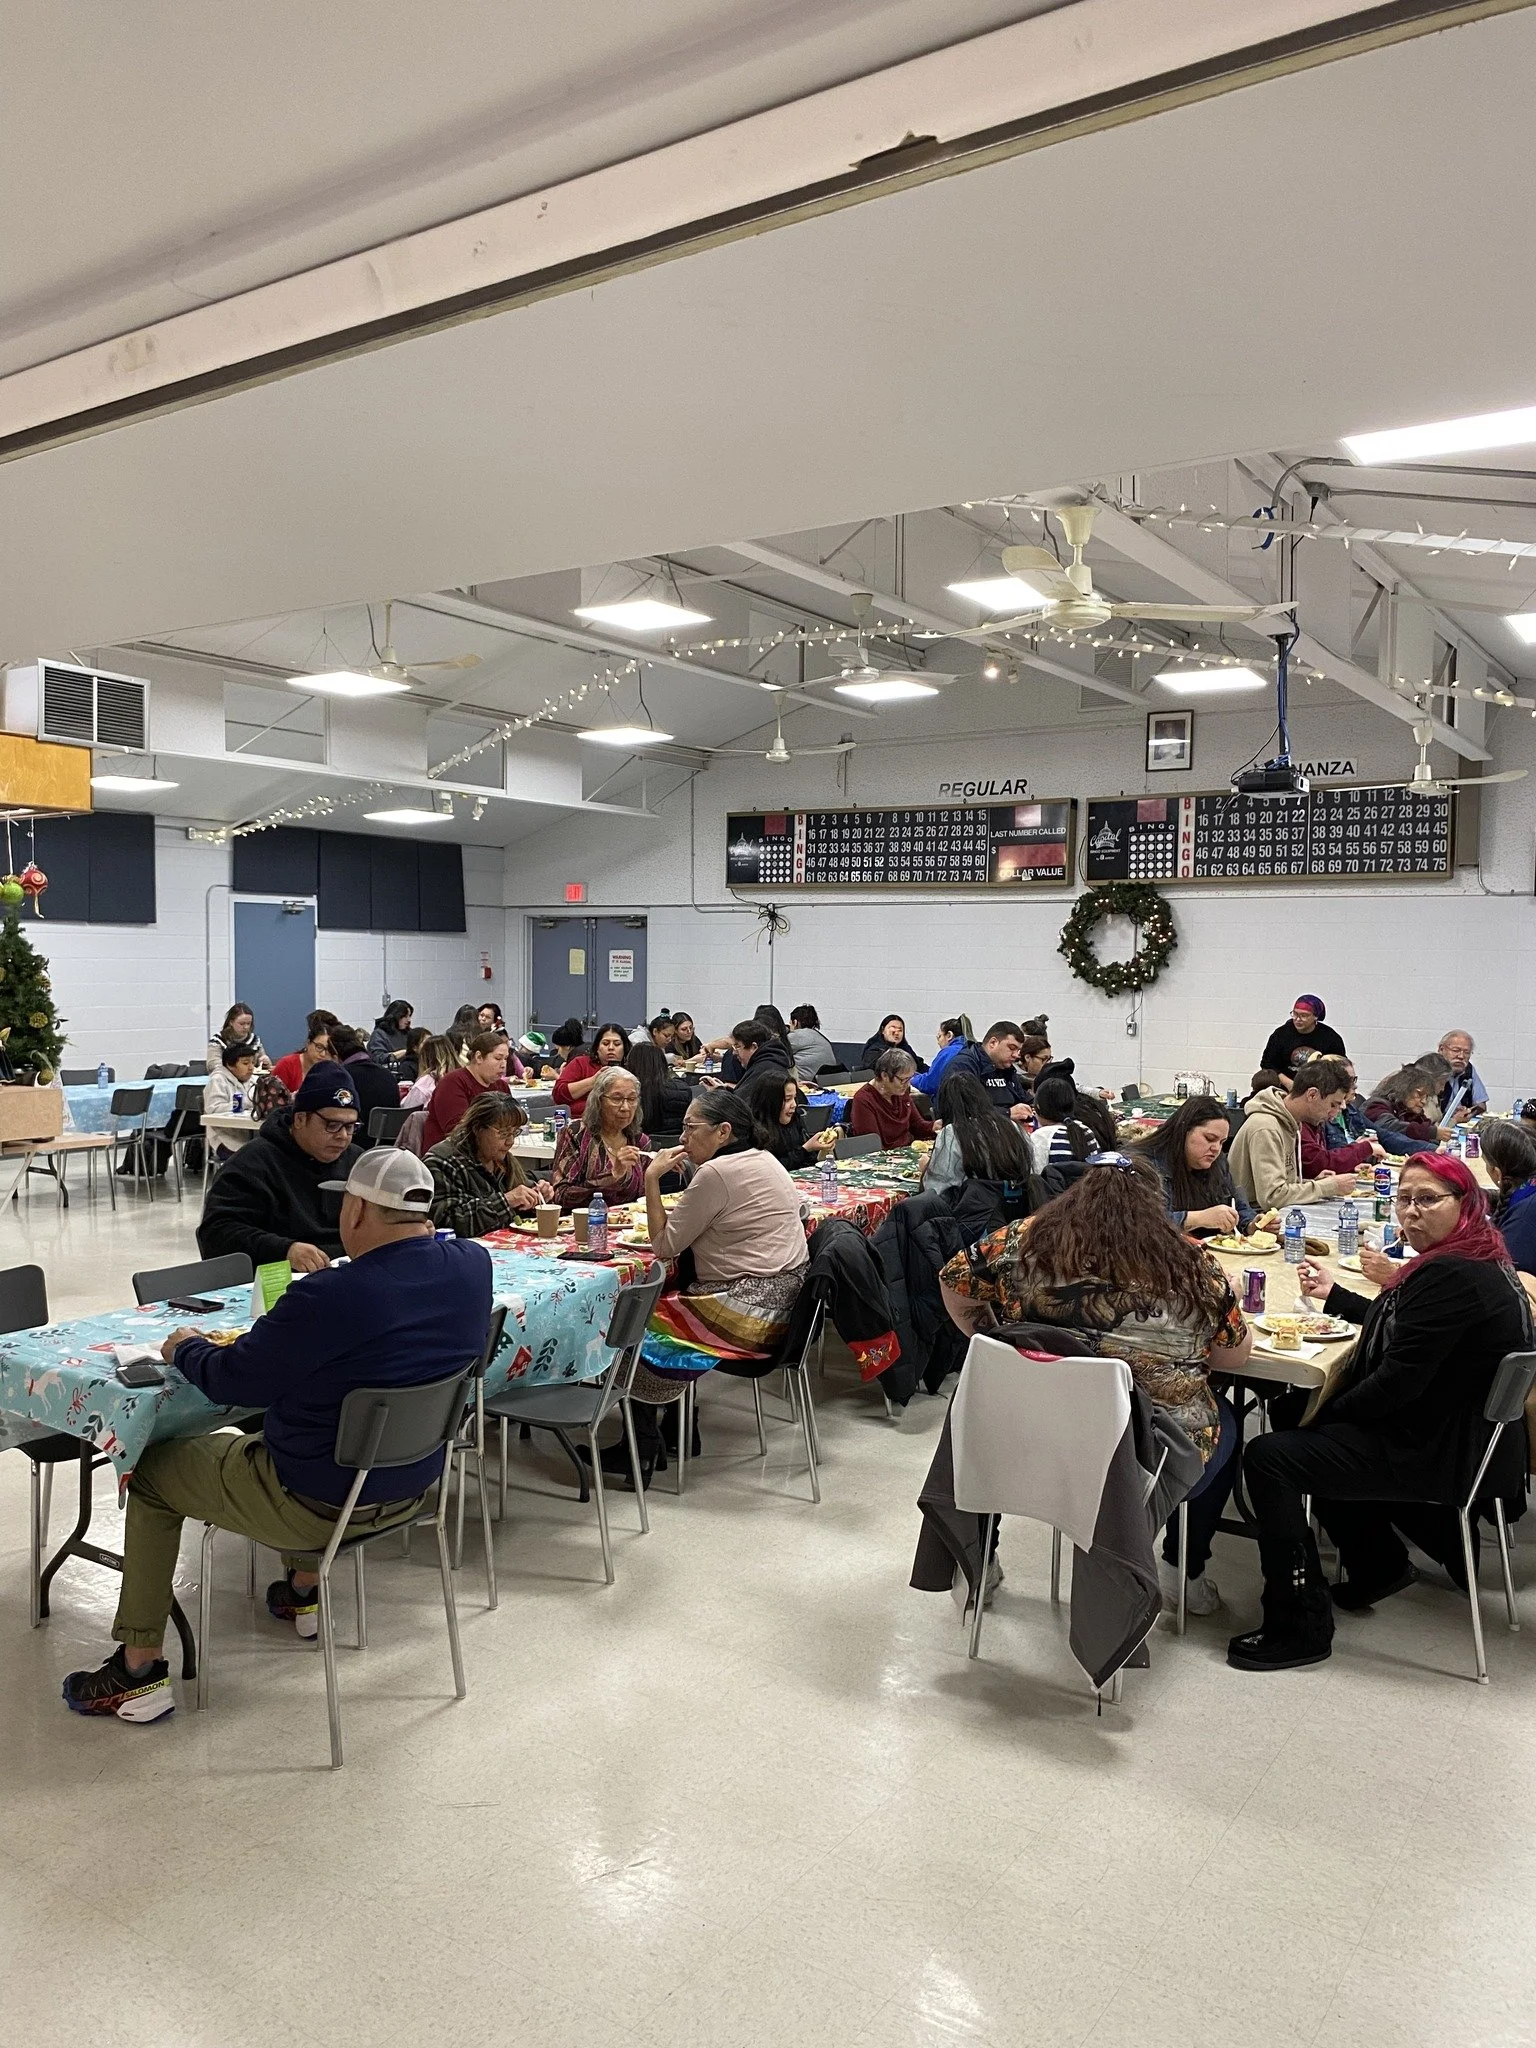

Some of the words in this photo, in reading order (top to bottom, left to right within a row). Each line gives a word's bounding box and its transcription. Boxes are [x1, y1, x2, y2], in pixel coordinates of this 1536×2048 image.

[1292, 761, 1355, 776] NANZA
[939, 779, 1028, 797] REGULAR
[810, 815, 813, 825] 1
[821, 815, 826, 825] 2
[832, 814, 837, 825] 3
[843, 814, 848, 824] 4
[855, 814, 860, 824] 5
[866, 813, 872, 824] 6
[878, 813, 884, 823] 7
[892, 813, 898, 823] 8
[905, 812, 910, 823] 9
[915, 812, 924, 822] 10
[928, 811, 936, 822] 11
[940, 811, 949, 822] 12
[952, 810, 961, 821] 13
[965, 810, 973, 821] 14
[977, 809, 986, 820] 15
[1229, 813, 1240, 825] 18
[1245, 812, 1256, 824] 19
[1260, 811, 1273, 824] 20
[1276, 810, 1288, 823] 21
[1313, 808, 1326, 821] 23
[1330, 808, 1343, 821] 24
[1347, 807, 1360, 820] 25
[1364, 806, 1378, 819] 26
[1381, 806, 1395, 819] 27
[1399, 805, 1413, 818] 28
[1416, 804, 1430, 817] 29
[808, 829, 816, 839] 16
[819, 829, 827, 839] 17
[830, 829, 838, 839] 18
[842, 828, 850, 839] 19
[852, 828, 862, 839] 20
[864, 828, 873, 838] 21
[875, 827, 885, 838] 22
[889, 827, 899, 838] 23
[902, 827, 911, 837] 24
[914, 826, 924, 837] 25
[926, 826, 936, 837] 26
[938, 825, 949, 836] 27
[951, 825, 961, 836] 28
[963, 825, 974, 836] 29
[976, 824, 987, 836] 30
[1039, 827, 1066, 835] CALLED
[1129, 823, 1174, 832] BINGO
[1197, 831, 1208, 843] 31
[1212, 830, 1224, 842] 32
[1227, 829, 1240, 842] 33
[1243, 829, 1256, 841] 34
[1259, 828, 1272, 841] 35
[1275, 828, 1288, 840] 36
[1291, 827, 1305, 840] 37
[1312, 826, 1326, 838] 38
[1329, 825, 1343, 838] 39
[1346, 825, 1360, 837] 40
[1364, 824, 1377, 837] 41
[1380, 823, 1395, 836] 42
[1398, 822, 1412, 836] 43
[1415, 822, 1430, 835] 44
[1433, 822, 1448, 835] 45
[807, 843, 815, 854] 31
[818, 843, 827, 853] 32
[829, 843, 839, 853] 33
[840, 843, 850, 853] 34
[851, 842, 861, 853] 35
[863, 842, 873, 853] 36
[875, 842, 885, 853] 37
[889, 842, 899, 852] 38
[901, 841, 911, 852] 39
[913, 841, 923, 852] 40
[926, 841, 935, 852] 41
[938, 841, 948, 851] 42
[950, 840, 961, 851] 43
[963, 840, 973, 851] 44
[975, 840, 986, 851] 45
[1196, 847, 1208, 859] 46
[1211, 847, 1224, 859] 47
[1227, 846, 1240, 858] 48
[1243, 845, 1256, 858] 49
[1259, 845, 1272, 857] 50
[1276, 845, 1287, 857] 51
[1291, 844, 1304, 856] 52
[1312, 843, 1325, 856] 53
[1329, 843, 1342, 855] 54
[1346, 842, 1359, 855] 55
[1363, 842, 1376, 854] 56
[1380, 841, 1394, 854] 57
[1397, 840, 1411, 854] 58
[1415, 840, 1429, 853] 59
[1433, 839, 1447, 853] 60
[806, 857, 815, 867] 46
[817, 857, 827, 867] 47
[828, 857, 838, 868] 48
[840, 857, 850, 867] 49
[851, 857, 861, 867] 50
[863, 857, 872, 867] 51
[874, 856, 884, 867] 52
[888, 856, 898, 867] 53
[900, 856, 910, 867] 54
[913, 856, 923, 867] 55
[925, 856, 935, 867] 56
[937, 856, 947, 866] 57
[950, 855, 960, 866] 58
[962, 855, 972, 866] 59
[975, 855, 985, 866] 60
[1196, 864, 1207, 876] 61
[1211, 864, 1223, 876] 62
[1226, 863, 1239, 875] 63
[1242, 863, 1255, 875] 64
[1258, 862, 1271, 875] 65
[1274, 862, 1287, 874] 66
[1291, 861, 1304, 874] 67
[1311, 860, 1325, 873] 68
[1328, 860, 1342, 872] 69
[1345, 859, 1359, 872] 70
[1363, 859, 1375, 872] 71
[1397, 858, 1411, 871] 73
[1415, 858, 1428, 871] 74
[1433, 858, 1446, 870] 75
[806, 872, 814, 882] 61
[817, 872, 826, 882] 62
[828, 872, 837, 882] 63
[839, 871, 849, 882] 64
[851, 871, 860, 882] 65
[862, 871, 872, 882] 66
[874, 871, 884, 882] 67
[888, 871, 898, 881] 68
[900, 871, 910, 881] 69
[912, 870, 922, 881] 70
[925, 871, 934, 881] 71
[937, 870, 947, 881] 72
[949, 870, 959, 881] 73
[962, 870, 971, 881] 74
[975, 870, 985, 881] 75
[1036, 868, 1063, 876] VALUE
[126, 1681, 164, 1698] SALOMON
